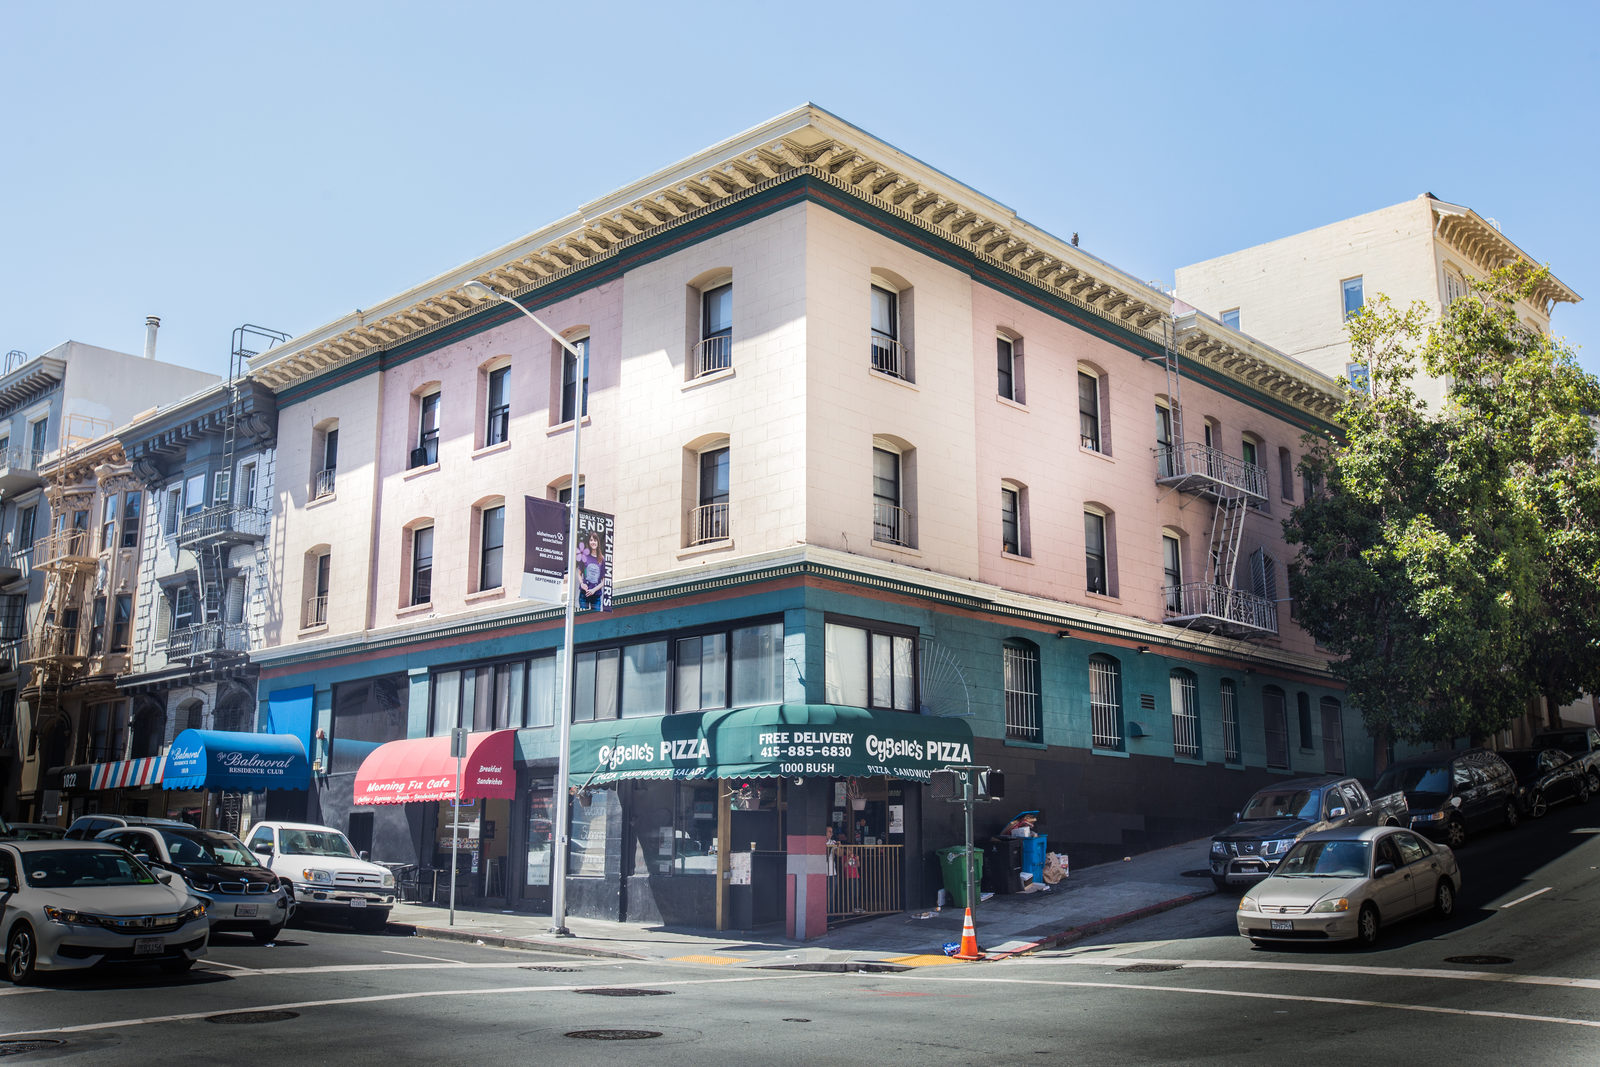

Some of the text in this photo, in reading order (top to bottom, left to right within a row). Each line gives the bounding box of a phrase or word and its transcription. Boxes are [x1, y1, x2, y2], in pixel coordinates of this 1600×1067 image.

[579, 519, 605, 533] END
[604, 517, 614, 607] ALZHEIMER'S
[542, 568, 562, 577] FRANCISCO
[759, 732, 854, 745] FREE DELIVERY
[660, 738, 711, 761] PIZZA
[760, 746, 852, 757] 415-885-6830
[926, 740, 972, 763] PIZZA
[224, 752, 295, 769] Balmoral
[779, 763, 835, 773] 1000 BUSH
[596, 767, 707, 780] PIZZA SANDWICHES SALADS
[867, 764, 932, 779] PIZZA SANDWICH
[63, 773, 77, 788] 1022
[366, 781, 406, 793] Morning
[426, 777, 450, 789] Cafe
